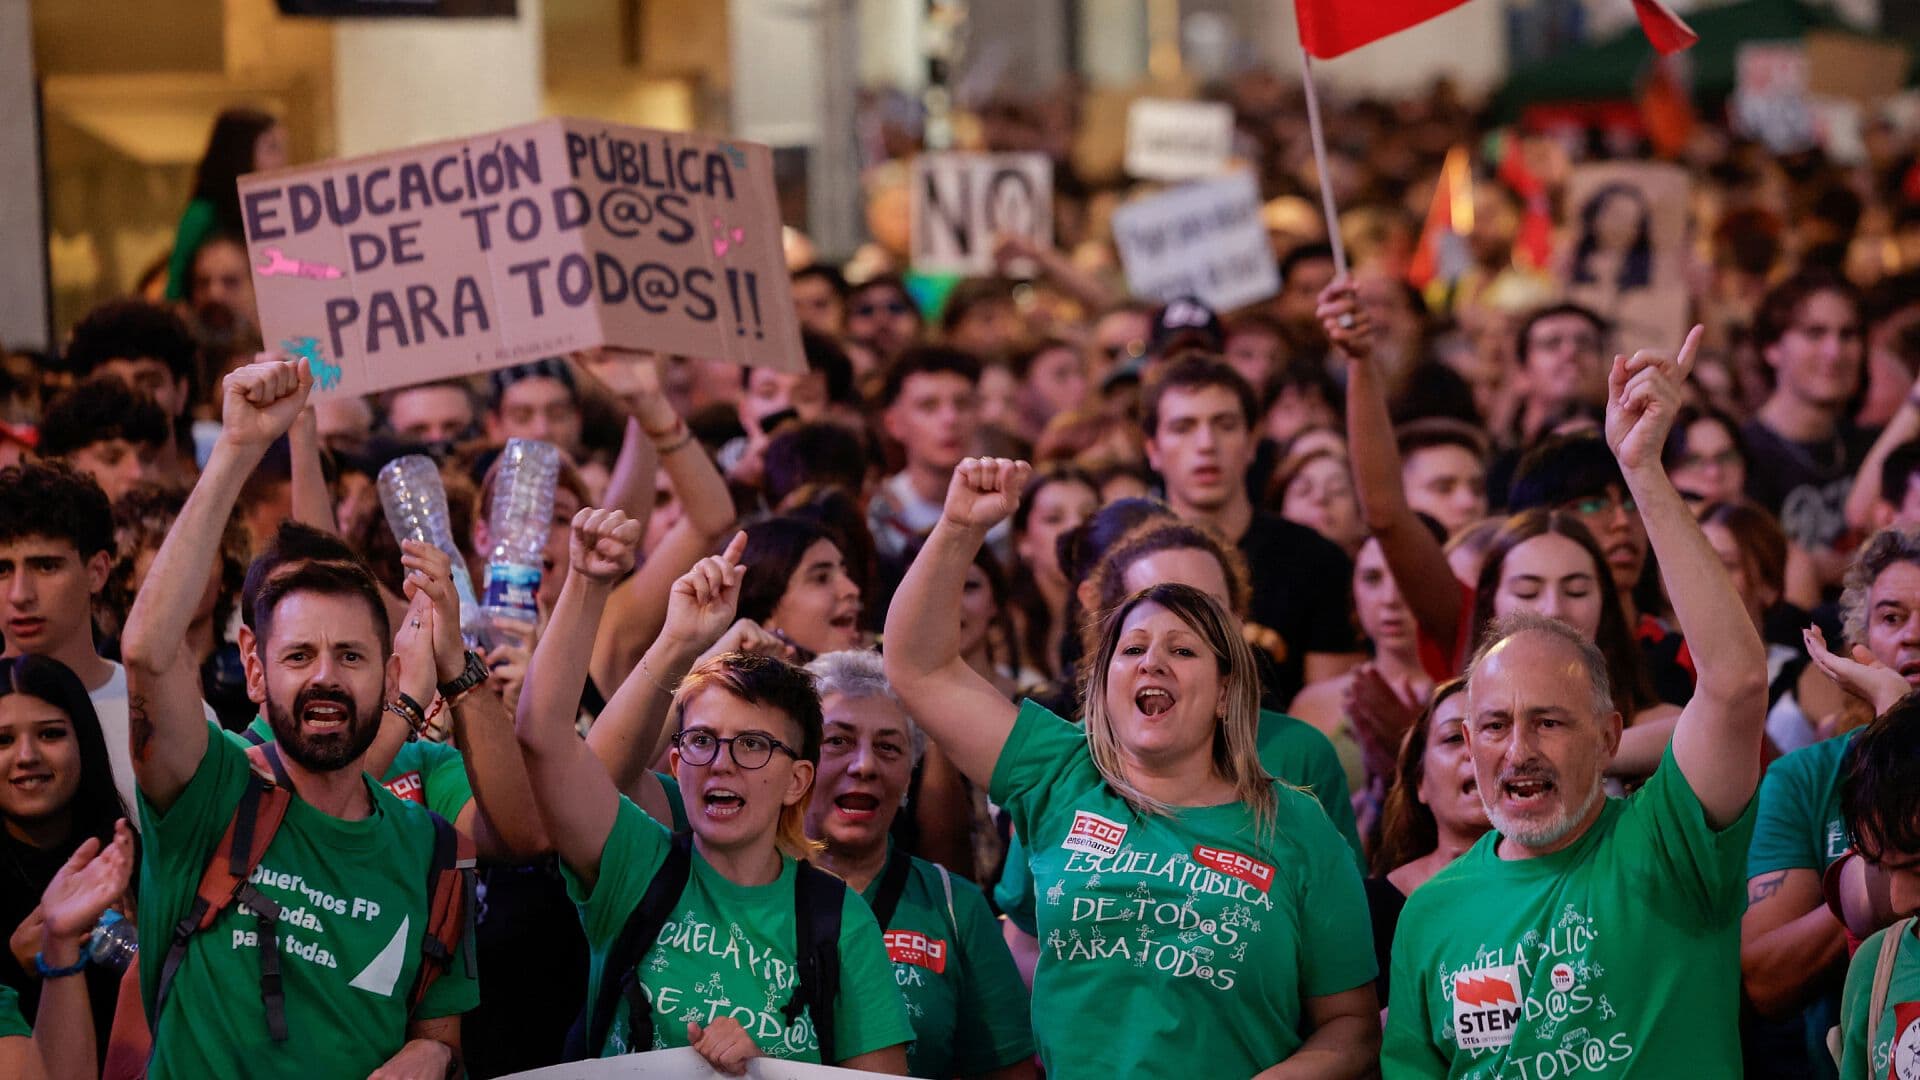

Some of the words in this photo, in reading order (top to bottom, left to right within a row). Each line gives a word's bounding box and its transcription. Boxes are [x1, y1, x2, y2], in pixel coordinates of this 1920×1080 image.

[245, 140, 541, 242] EDUCACIÓN
[565, 128, 735, 200] PÚBLICA
[350, 221, 424, 272] DE
[460, 187, 695, 250] TOD@S
[326, 276, 489, 358] PARA
[1064, 851, 1175, 883] ESCUELA
[1198, 847, 1270, 880] CCOO
[351, 897, 381, 921] FP
[1071, 898, 1120, 922] DE
[1132, 898, 1239, 946] TOD@S
[1053, 936, 1131, 961] PARA
[1137, 937, 1237, 991] TOD@S
[1458, 1007, 1522, 1034] STEM
